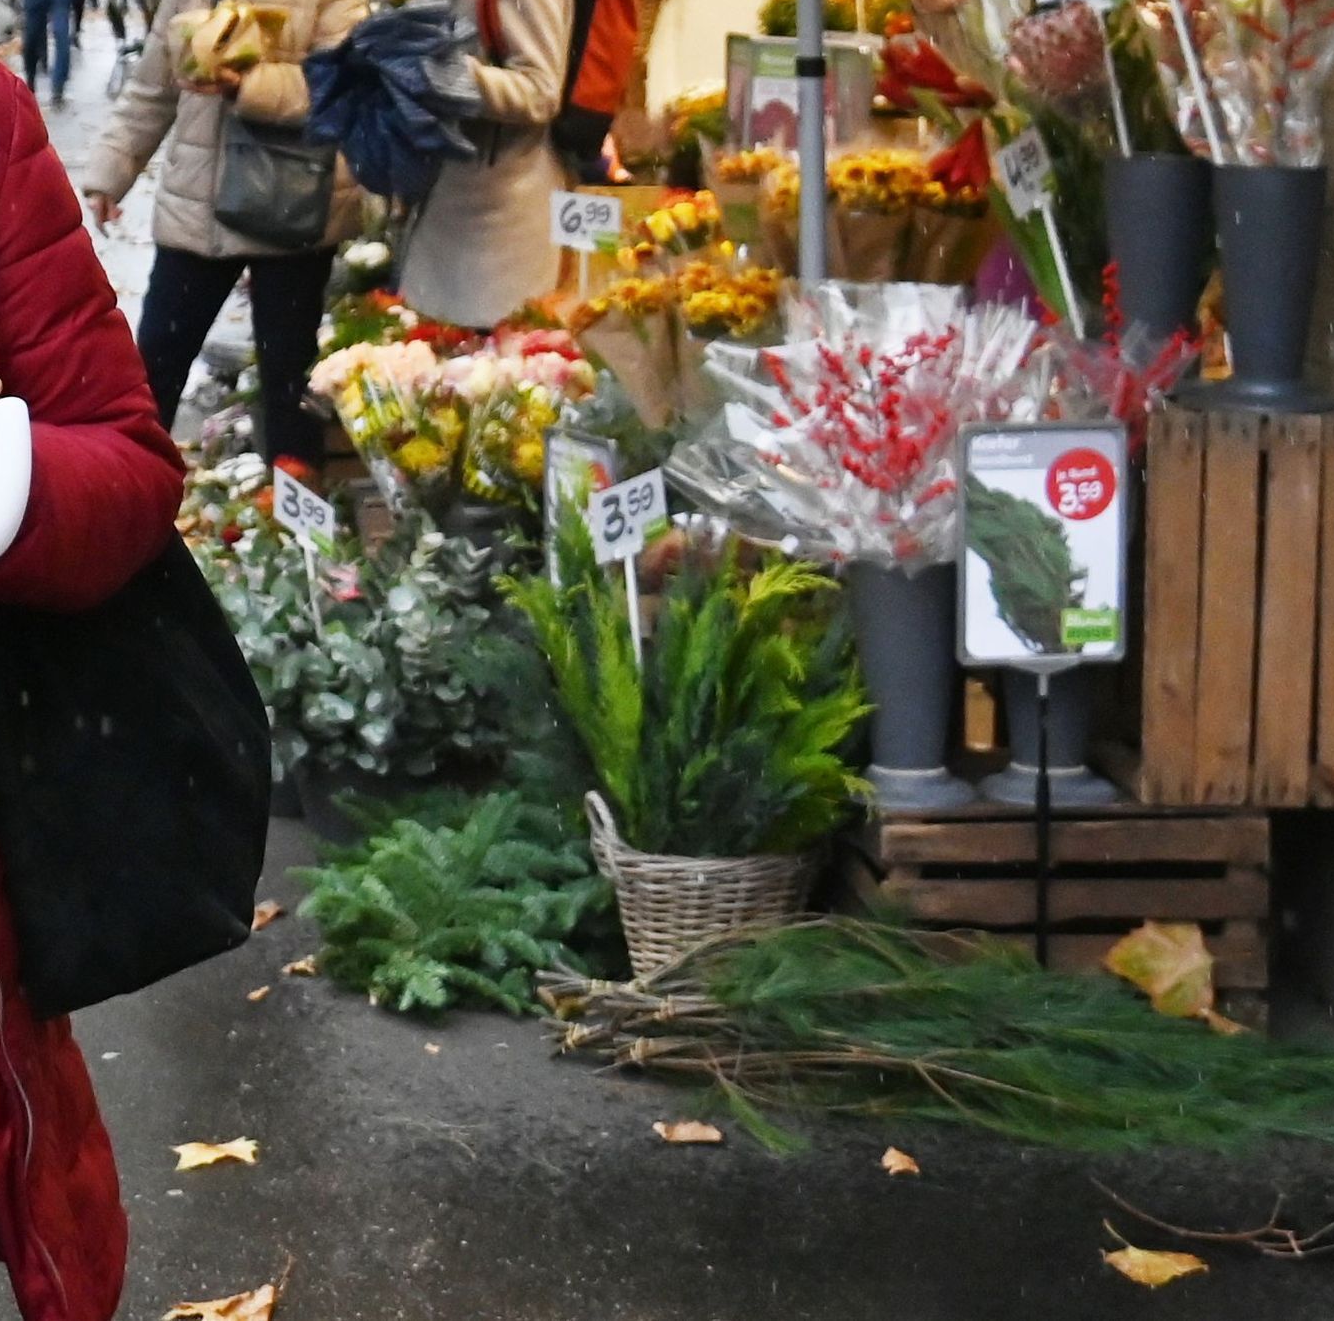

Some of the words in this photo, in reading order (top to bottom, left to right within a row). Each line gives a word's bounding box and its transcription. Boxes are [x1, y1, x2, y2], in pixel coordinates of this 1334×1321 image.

[559, 198, 611, 235] 6.99
[282, 480, 326, 527] 3.99
[601, 482, 655, 543] 3.59
